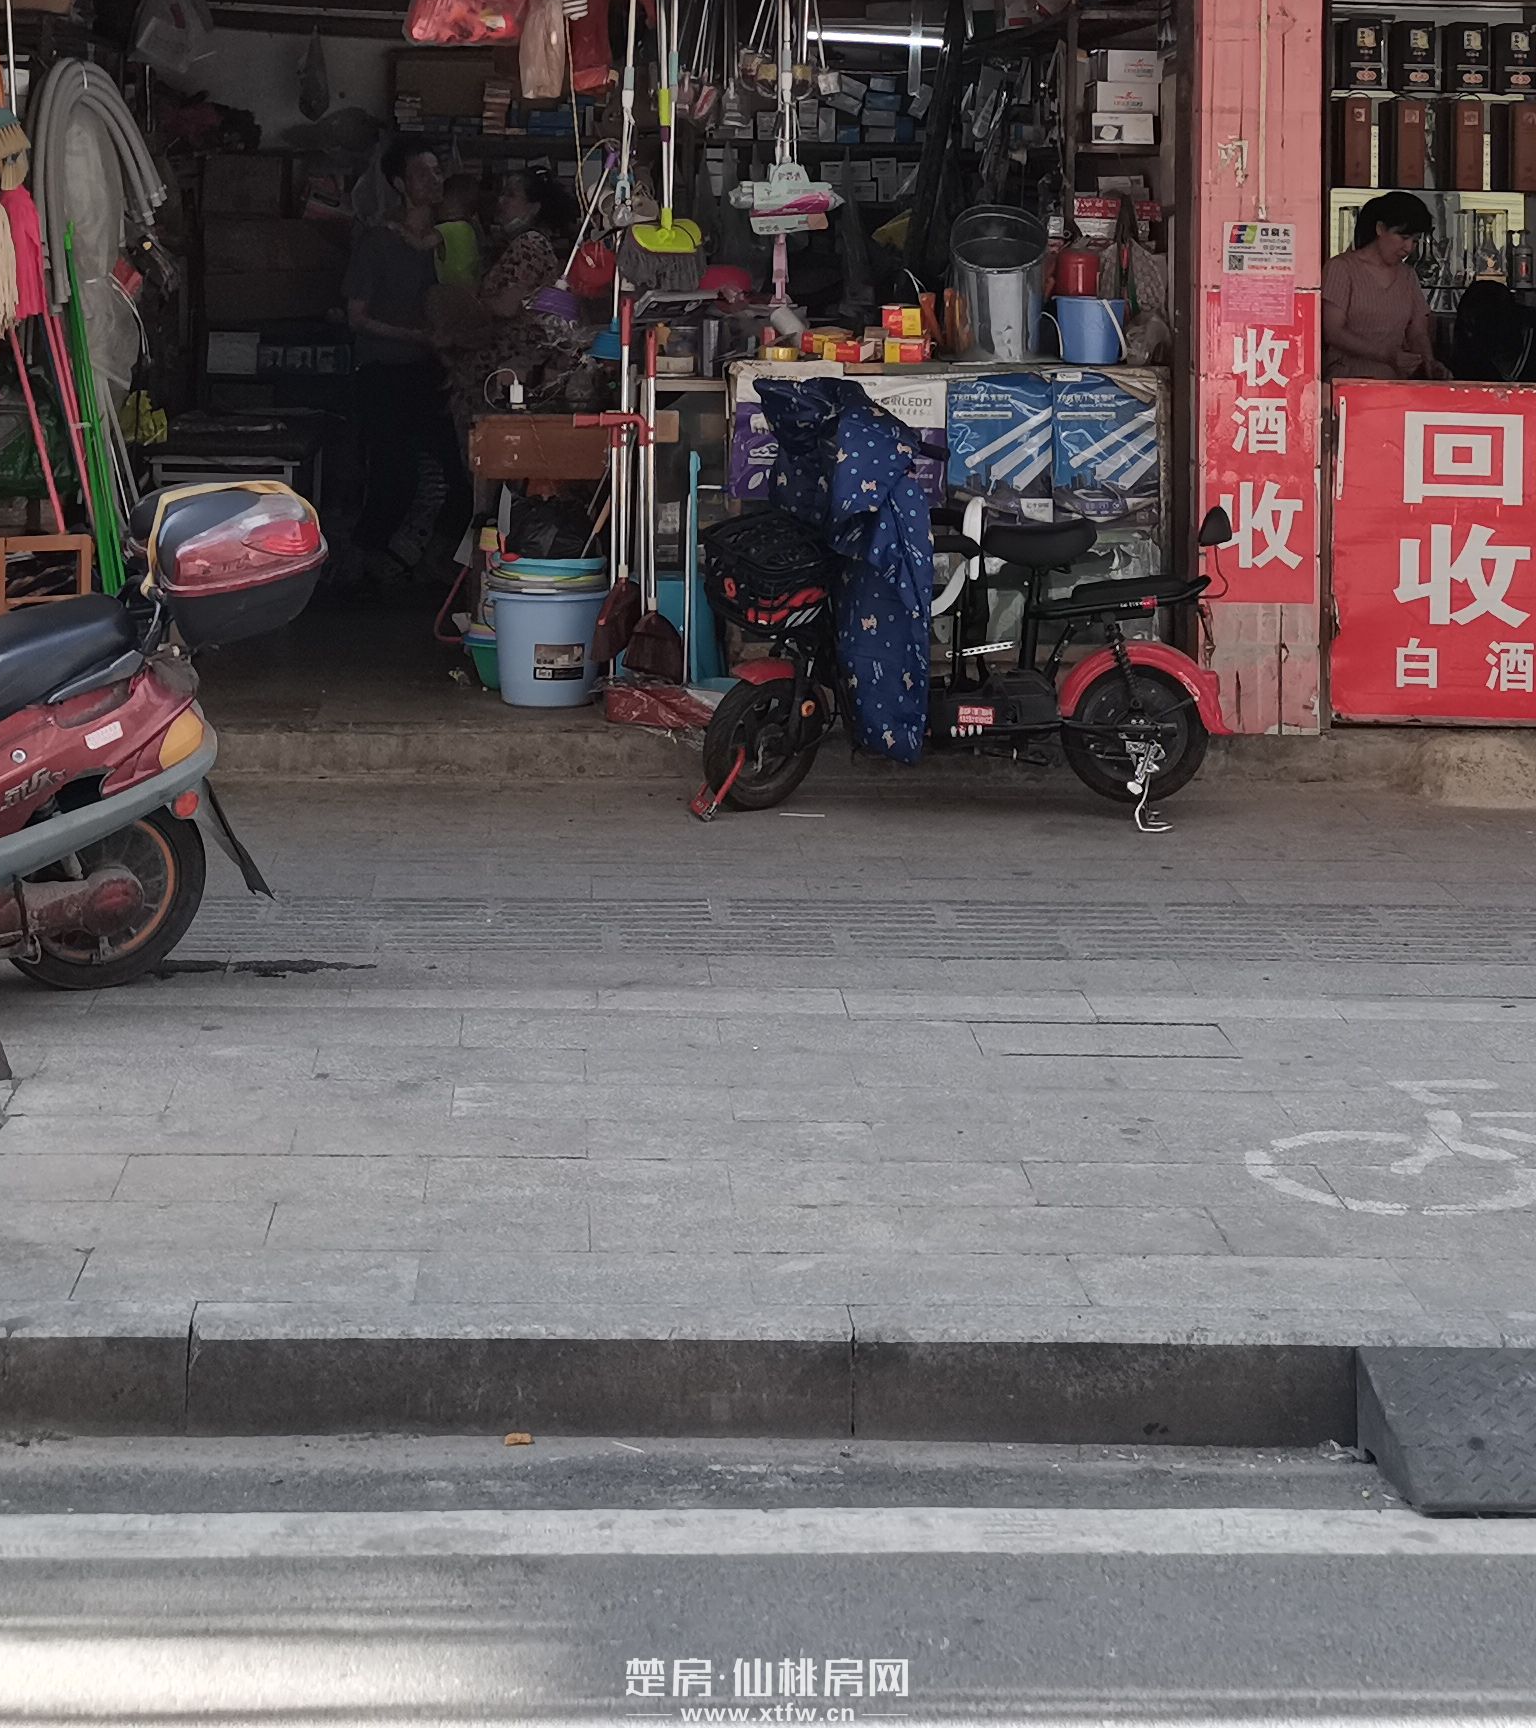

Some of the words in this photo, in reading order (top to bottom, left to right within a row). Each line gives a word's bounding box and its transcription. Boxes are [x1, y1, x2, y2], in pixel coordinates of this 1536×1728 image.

[1232, 327, 1291, 455] 收酒
[1216, 480, 1304, 570] 收
[1393, 410, 1532, 629] 回收
[1395, 638, 1535, 693] 白酒
